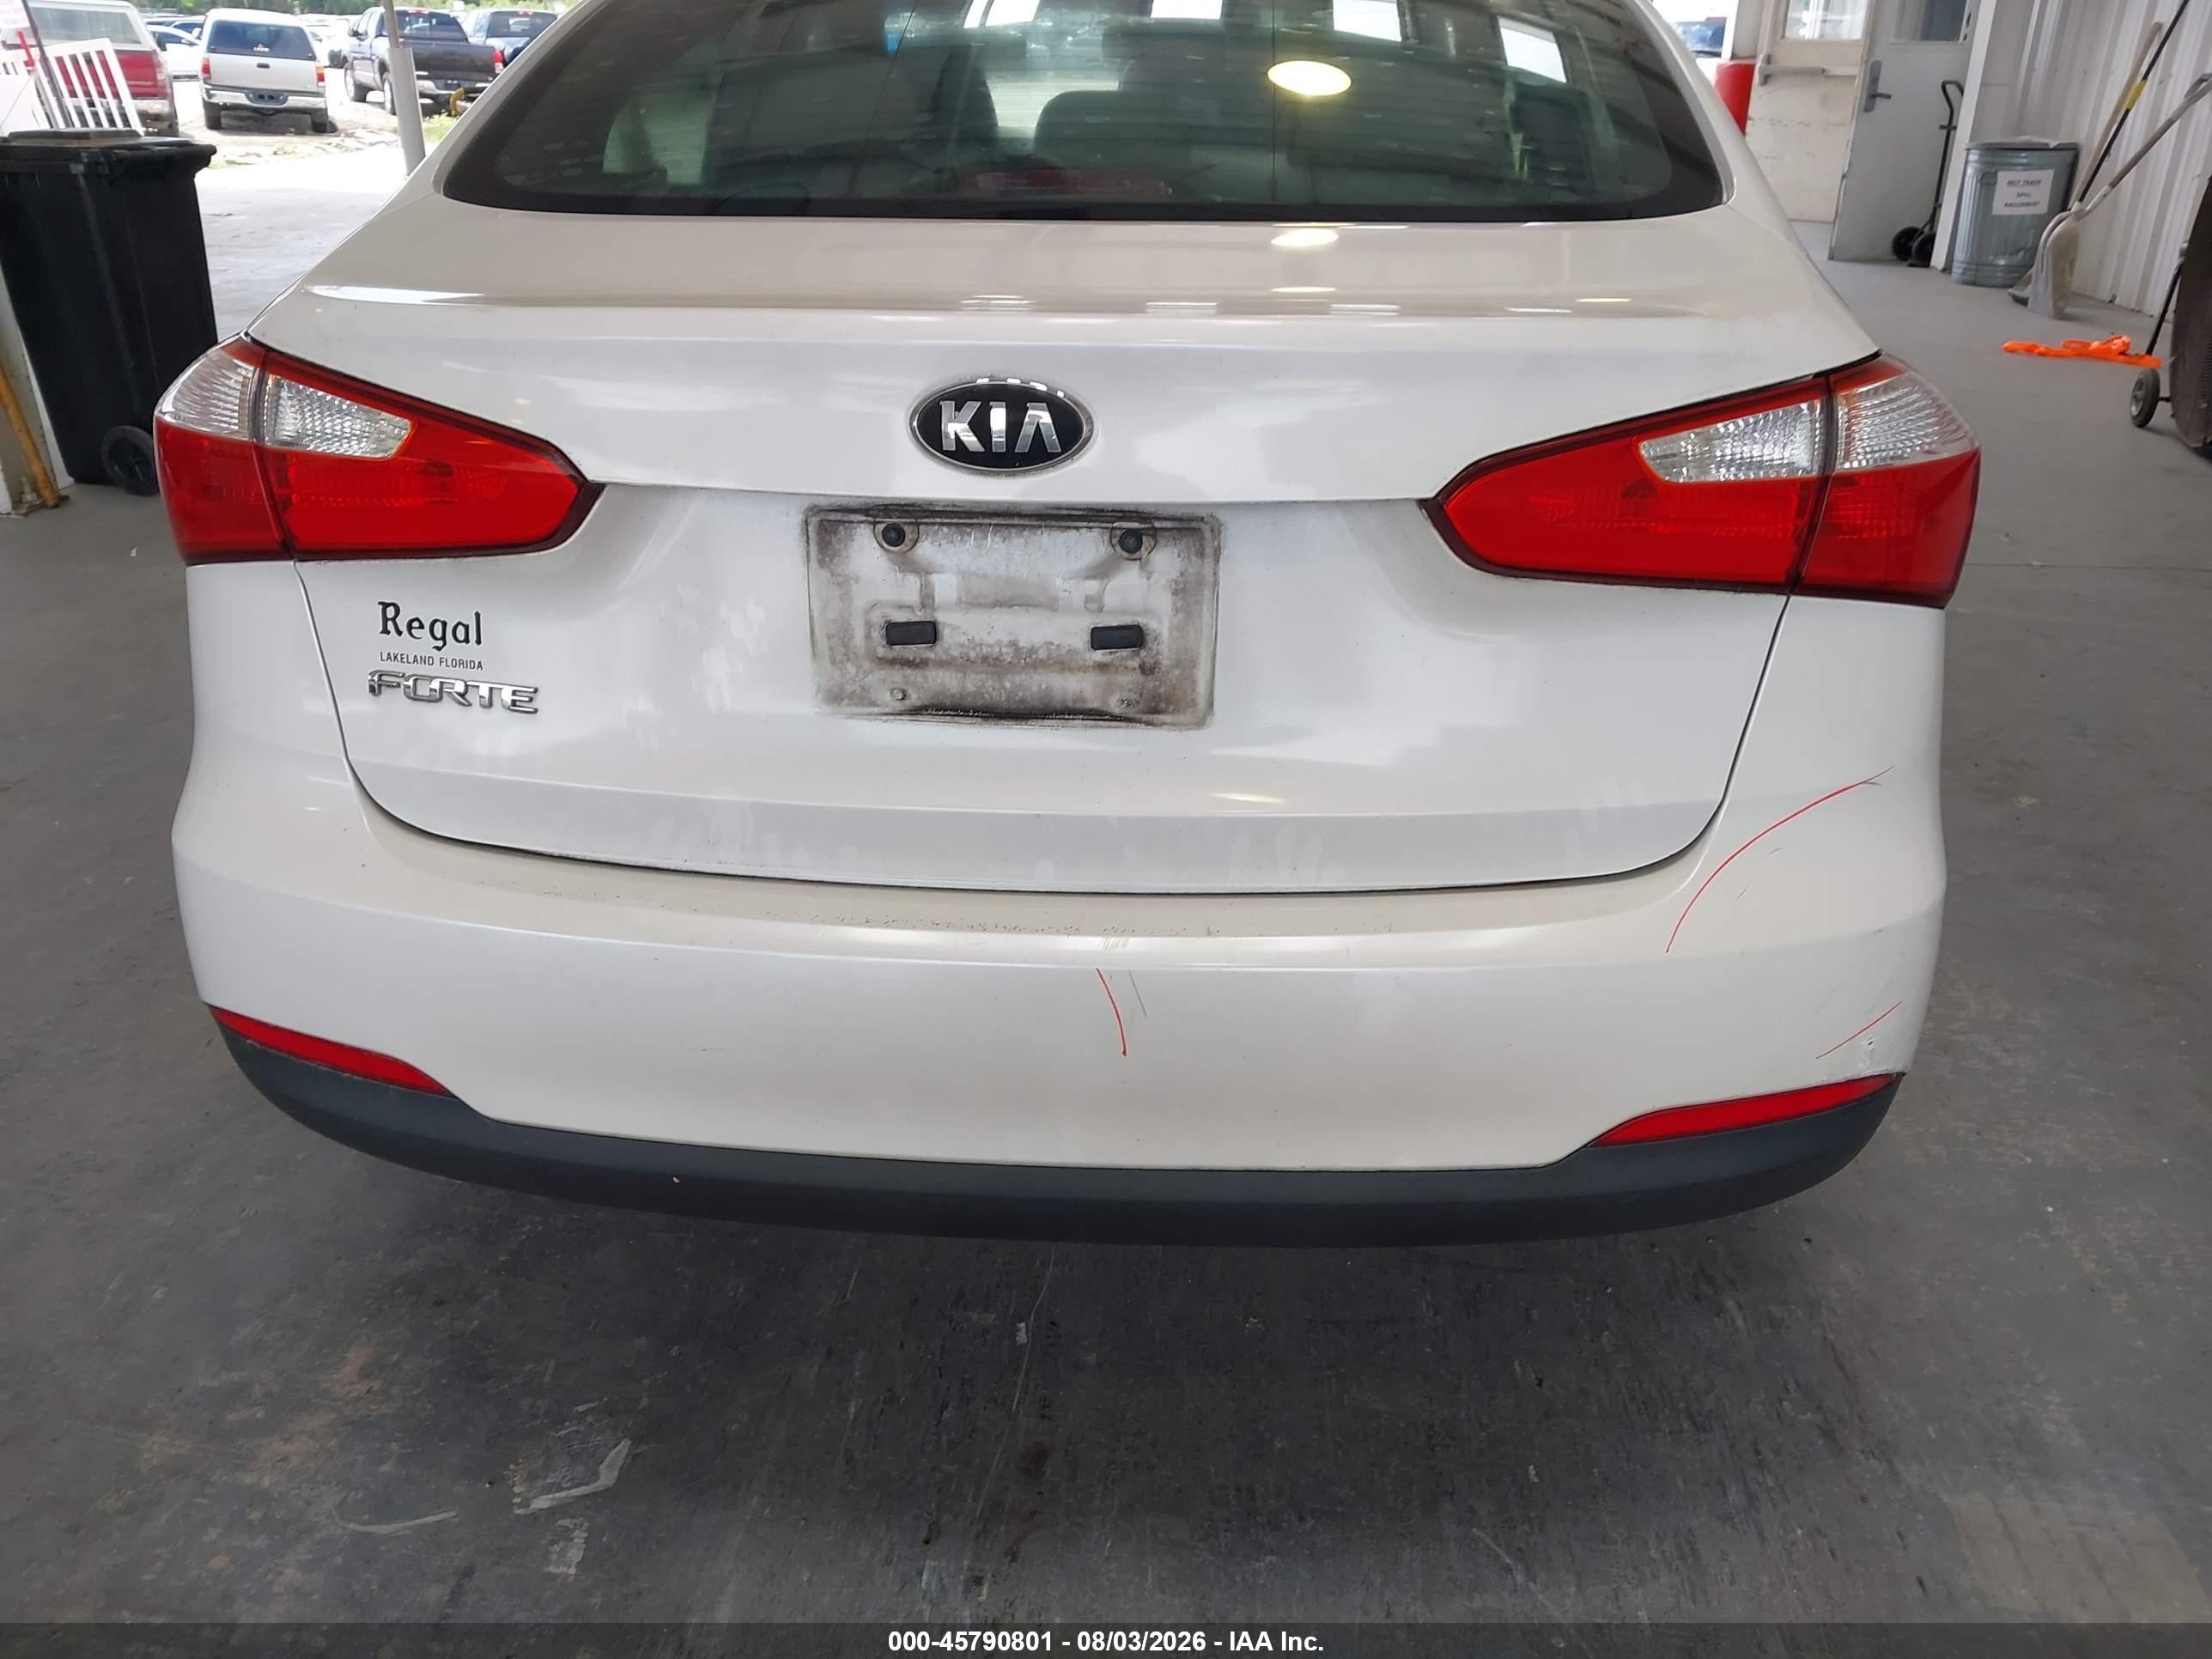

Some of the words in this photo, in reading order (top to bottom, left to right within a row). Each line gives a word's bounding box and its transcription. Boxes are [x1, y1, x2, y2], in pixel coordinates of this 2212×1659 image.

[939, 399, 1062, 453] KIA
[377, 600, 483, 652] Regal
[380, 651, 434, 666] LAKELAND
[439, 657, 483, 671] FLORIDA
[368, 669, 539, 714] FORTE
